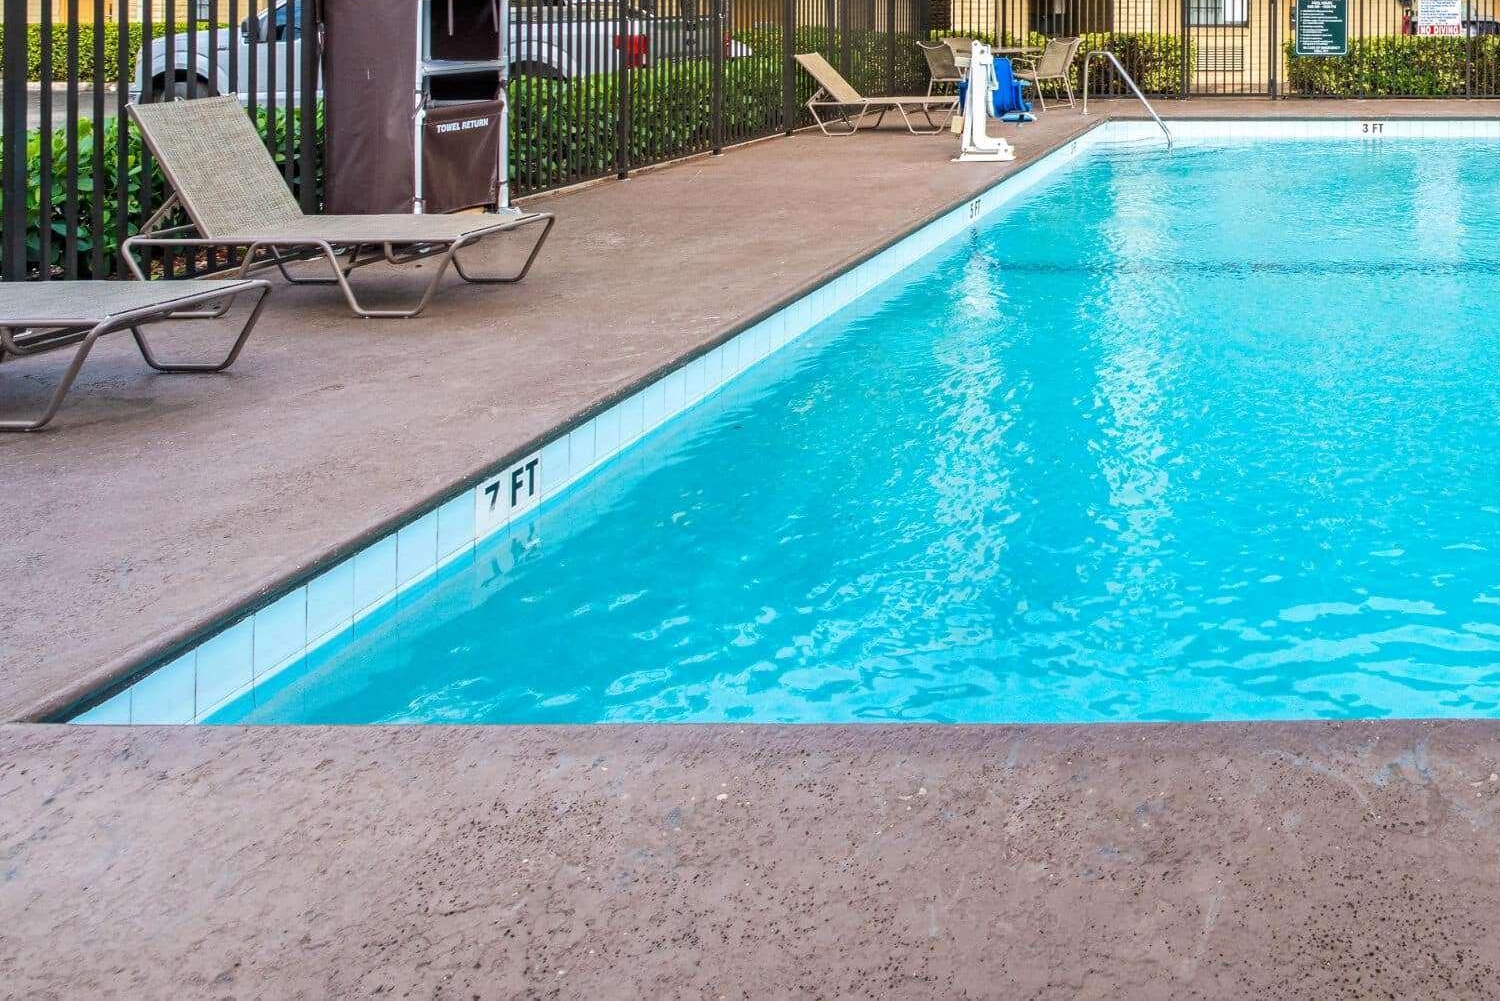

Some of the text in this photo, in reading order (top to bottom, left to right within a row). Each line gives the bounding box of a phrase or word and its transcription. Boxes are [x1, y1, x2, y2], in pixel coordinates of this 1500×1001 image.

[1420, 25, 1459, 34] NO DIVING
[437, 118, 488, 133] TOWEL RETURN
[1363, 123, 1384, 133] 3 FT
[484, 458, 539, 510] 7 FT
